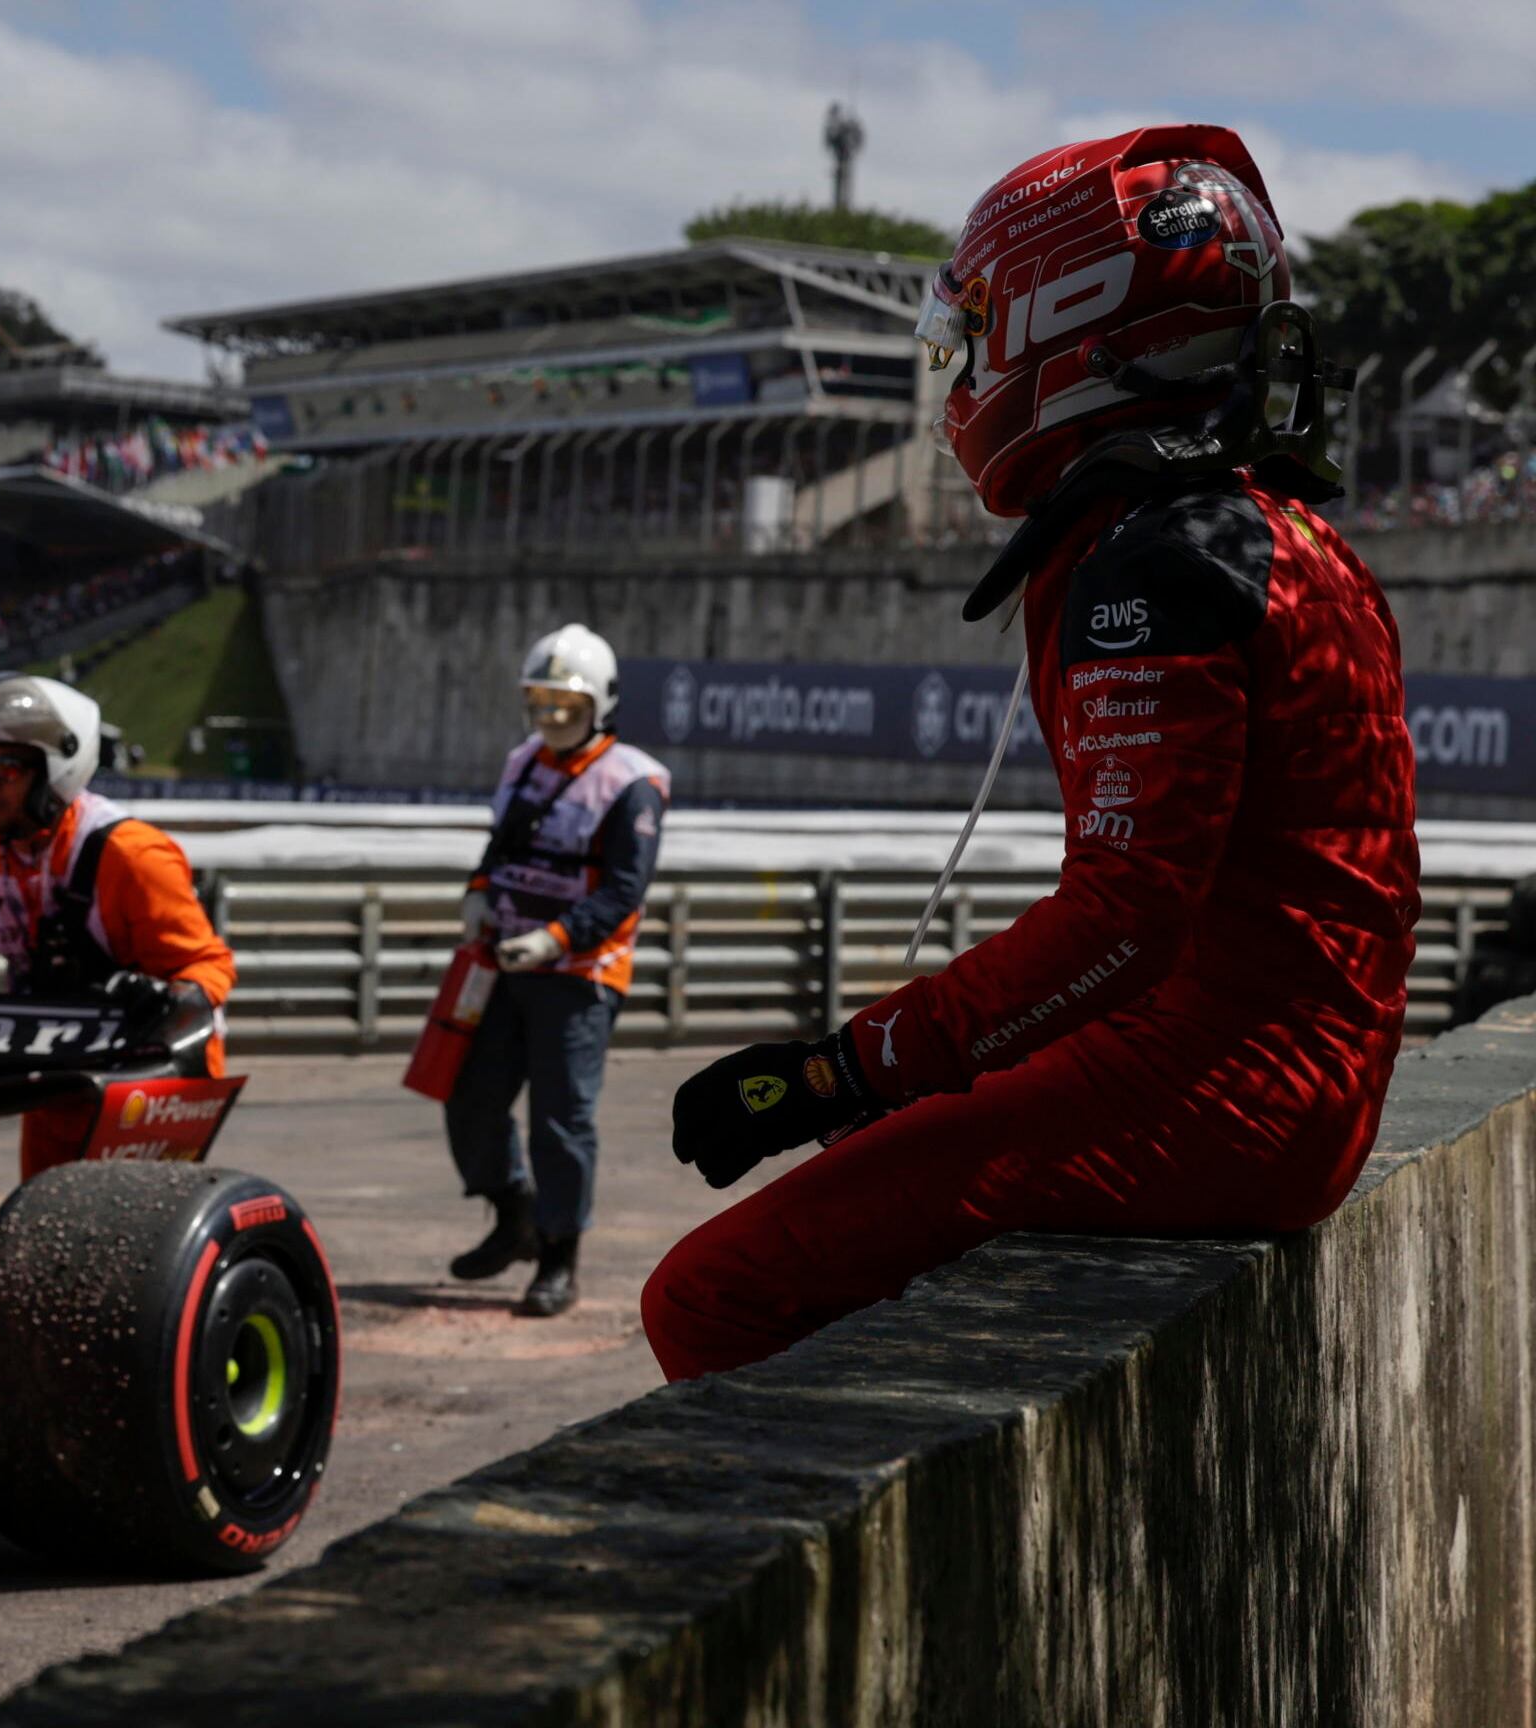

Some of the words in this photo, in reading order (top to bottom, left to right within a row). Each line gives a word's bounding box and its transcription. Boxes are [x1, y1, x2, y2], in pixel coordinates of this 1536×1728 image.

[1007, 185, 1096, 239] Bitdefender
[1154, 214, 1209, 238] Galicia
[1002, 251, 1136, 362] 16
[1089, 597, 1149, 631] aws
[1071, 664, 1166, 692] Bitdefender
[698, 674, 876, 744] crypto.com
[970, 993, 1068, 1062] RICHARD
[1067, 938, 1140, 999] MILLE
